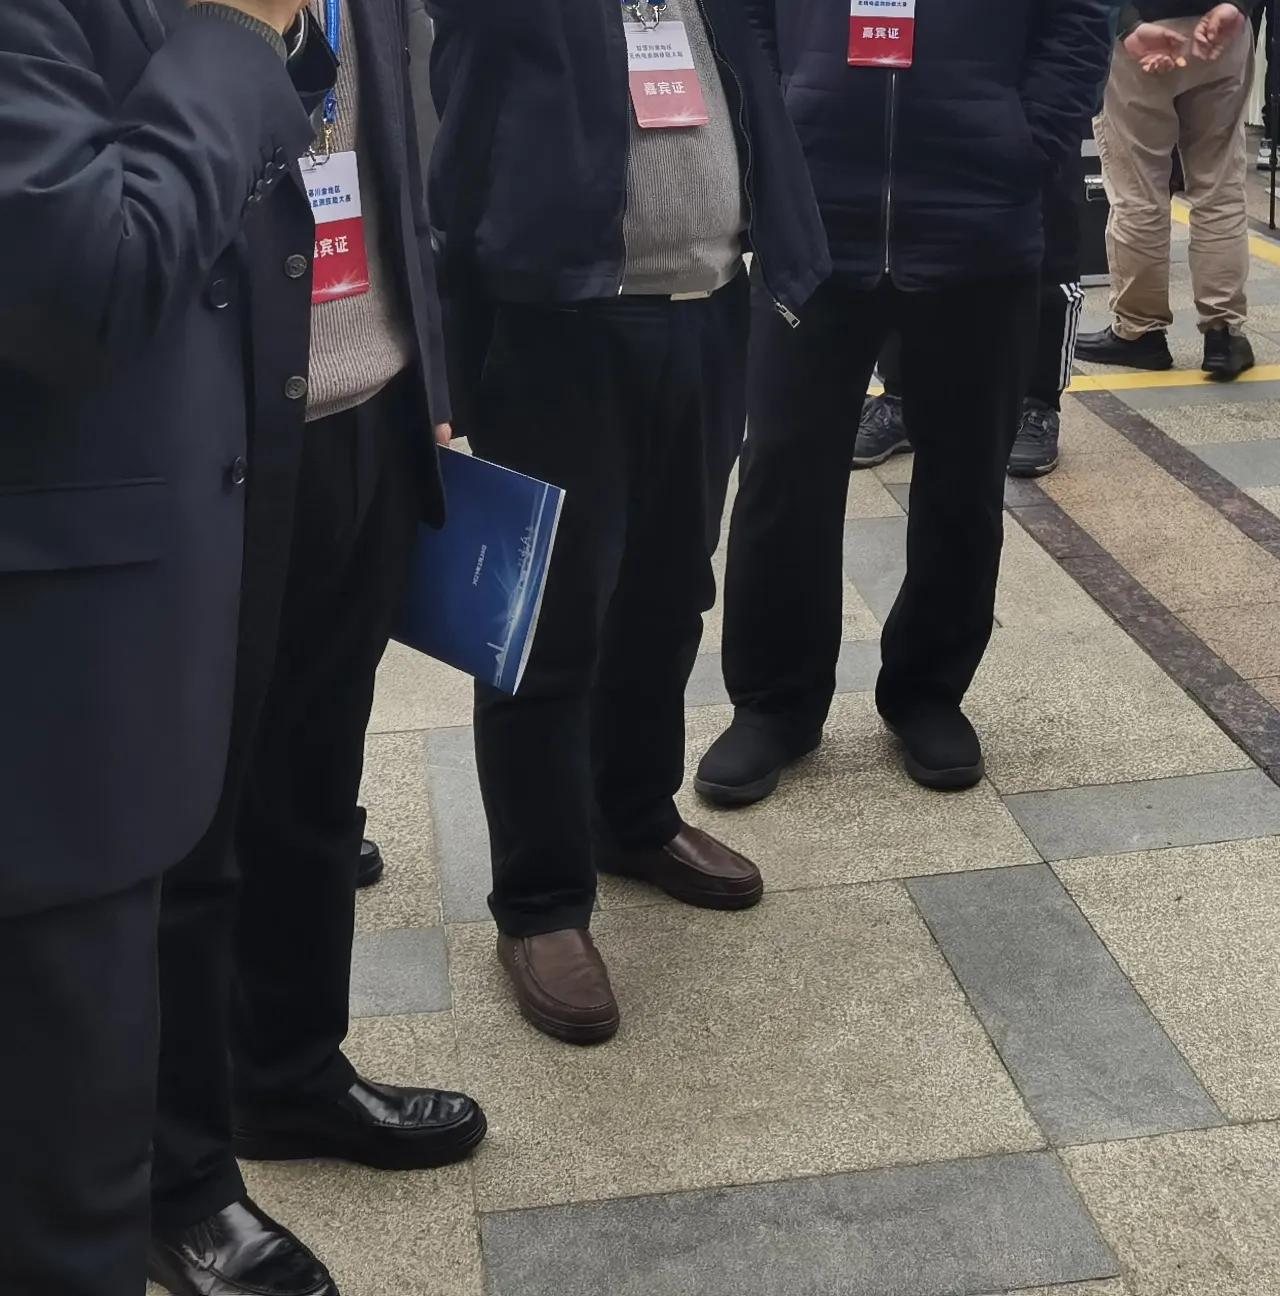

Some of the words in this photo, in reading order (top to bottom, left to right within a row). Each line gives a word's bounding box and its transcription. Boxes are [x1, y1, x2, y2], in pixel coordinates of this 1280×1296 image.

[862, 26, 900, 40] 嘉宾证
[643, 81, 686, 96] 嘉宾证
